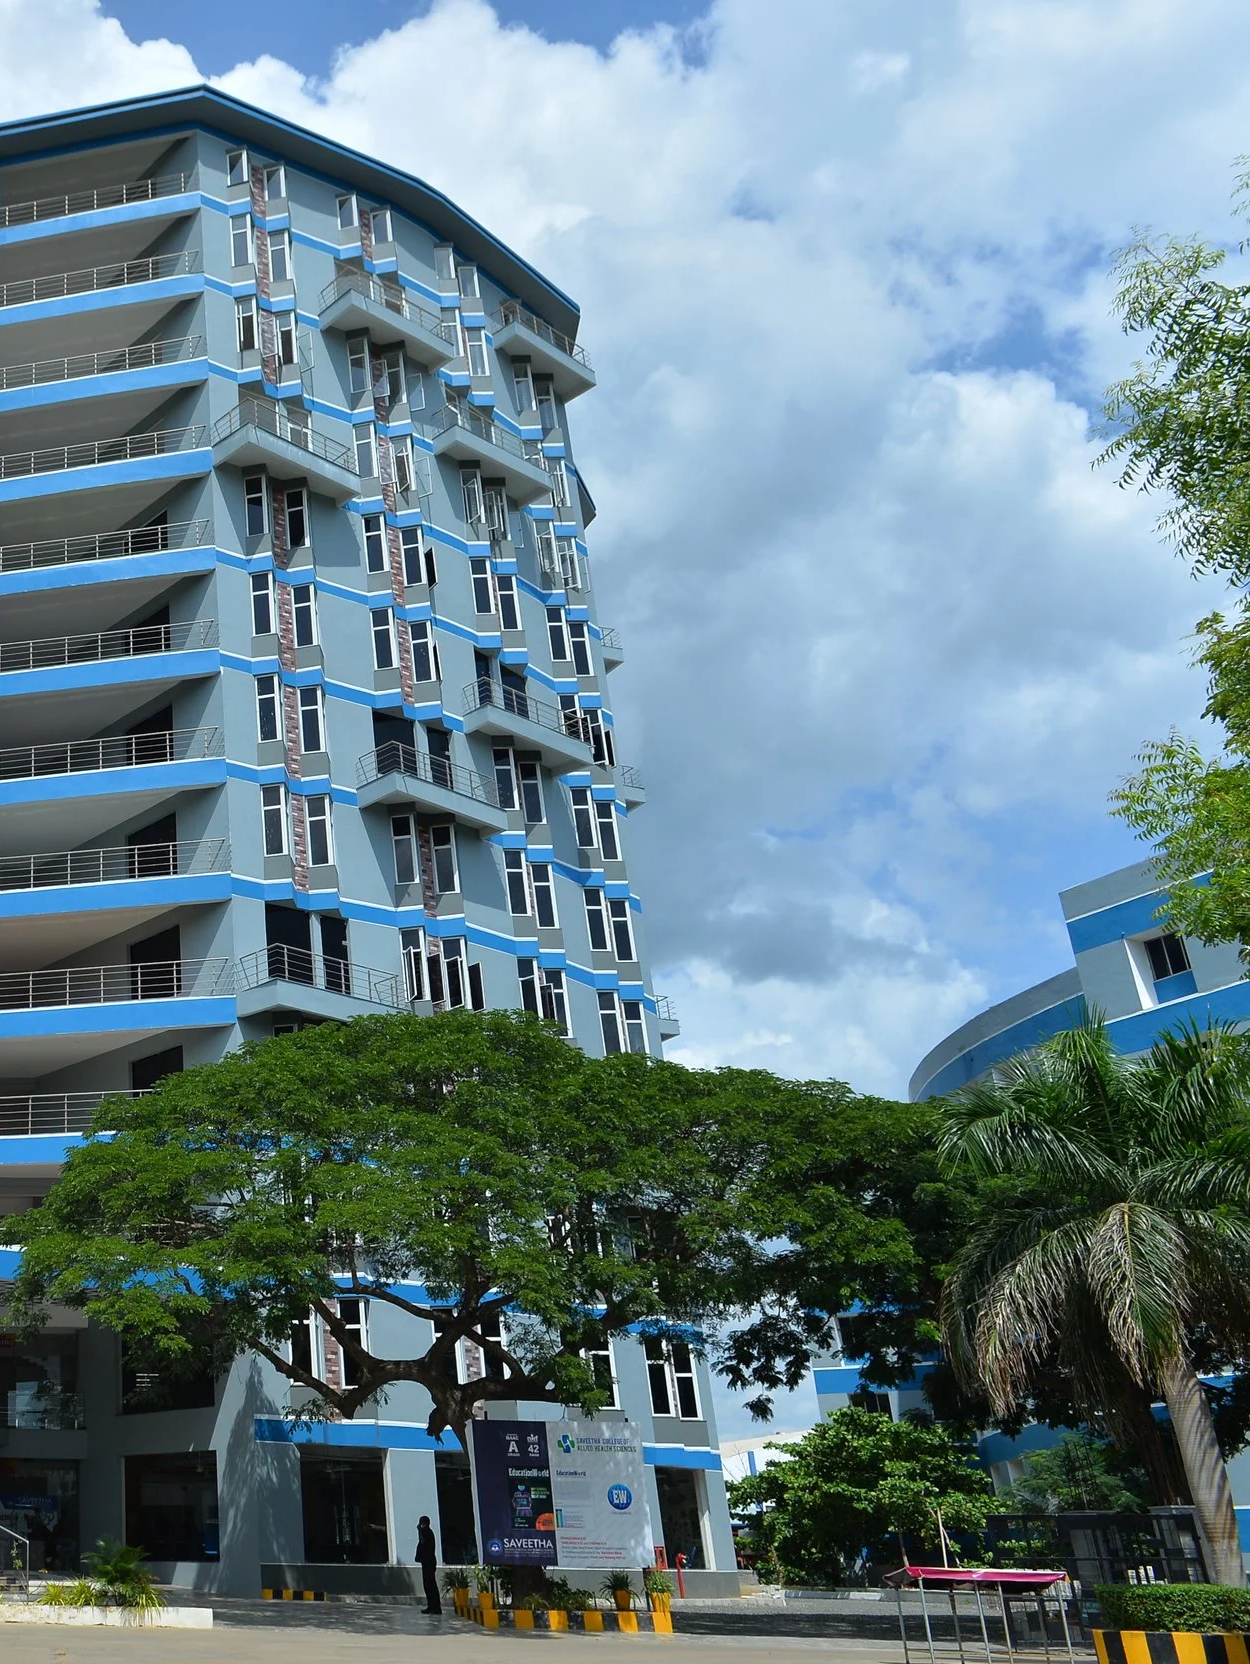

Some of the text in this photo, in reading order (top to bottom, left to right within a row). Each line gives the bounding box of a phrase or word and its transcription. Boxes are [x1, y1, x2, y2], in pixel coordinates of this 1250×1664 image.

[508, 1441, 519, 1453] A
[528, 1444, 539, 1453] 42
[612, 1489, 627, 1504] EW
[503, 1538, 554, 1549] SAVEETHA
